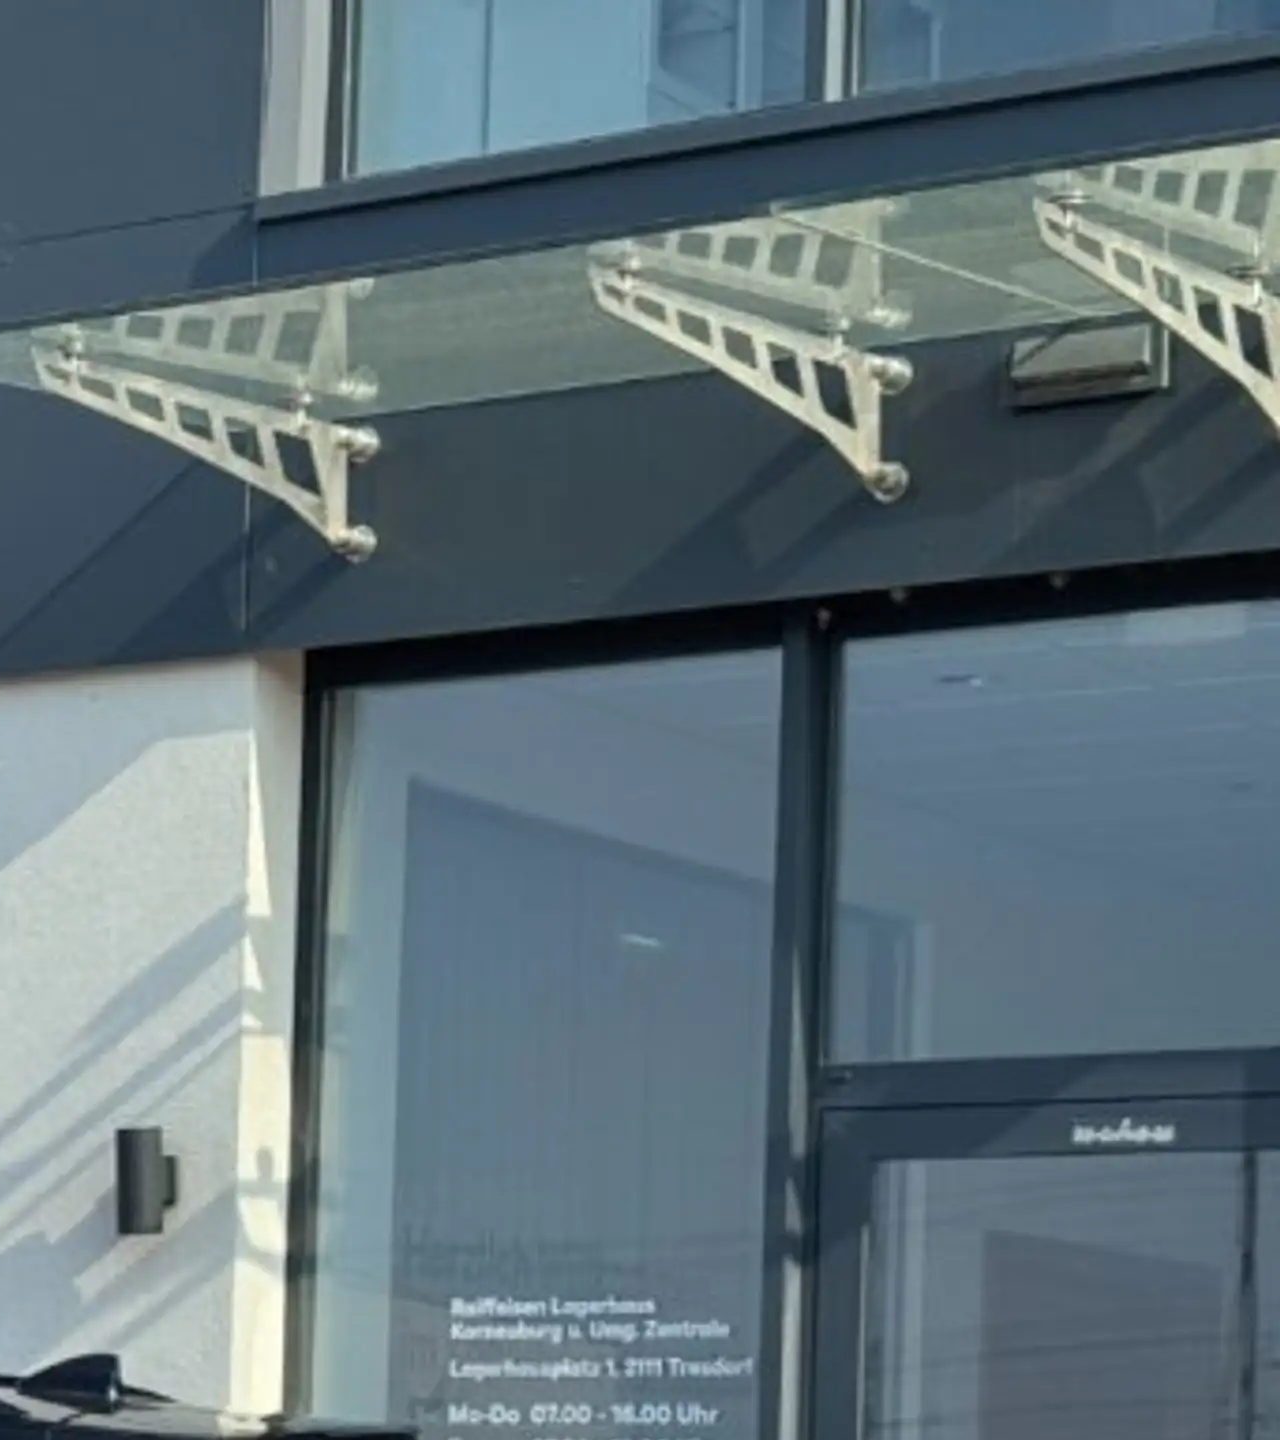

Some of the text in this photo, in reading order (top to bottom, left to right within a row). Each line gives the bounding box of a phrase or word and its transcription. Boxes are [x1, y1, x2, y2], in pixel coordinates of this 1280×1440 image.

[450, 1297, 656, 1319] Raiffeisen Lagerhaus
[644, 1319, 731, 1338] Zentrale
[449, 1358, 600, 1381] Lagerhausplatz
[624, 1358, 662, 1377] 2111
[667, 1357, 753, 1376] Tresdorf
[448, 1404, 520, 1425] Mo-Do
[530, 1404, 591, 1425] 07.00
[676, 1404, 718, 1425] Uhr
